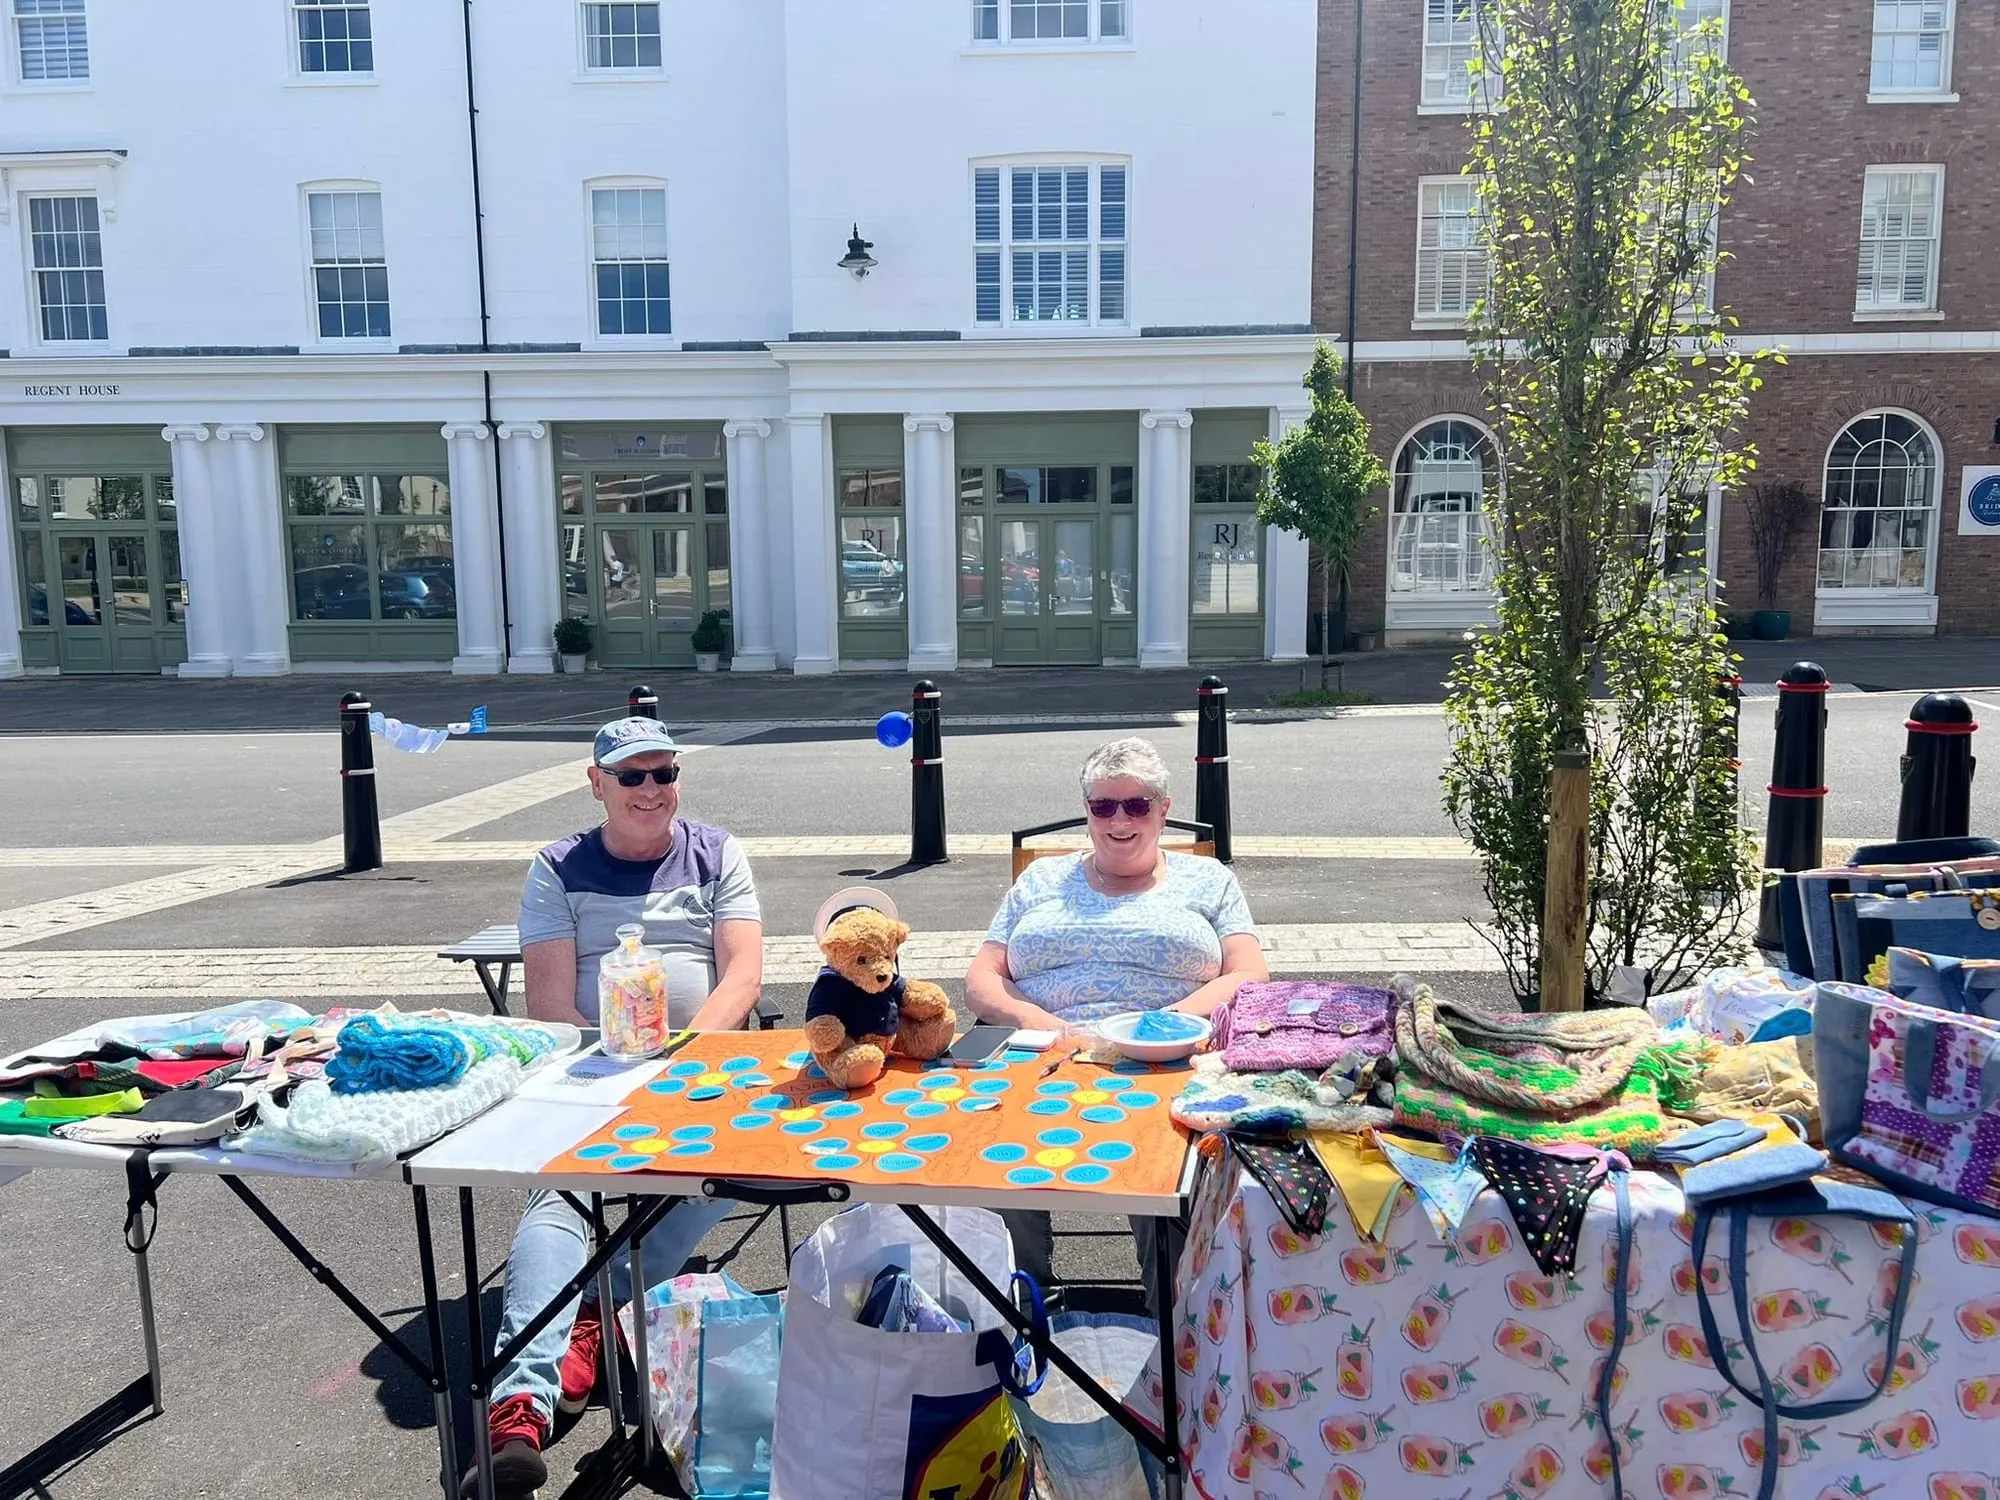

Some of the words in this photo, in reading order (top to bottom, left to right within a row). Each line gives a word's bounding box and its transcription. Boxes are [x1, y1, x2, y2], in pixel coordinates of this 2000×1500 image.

[1692, 337, 1737, 349] HSE
[24, 385, 71, 396] REGENT
[79, 384, 120, 396] HOUSE
[860, 529, 884, 552] RJ
[1212, 523, 1240, 549] RJ
